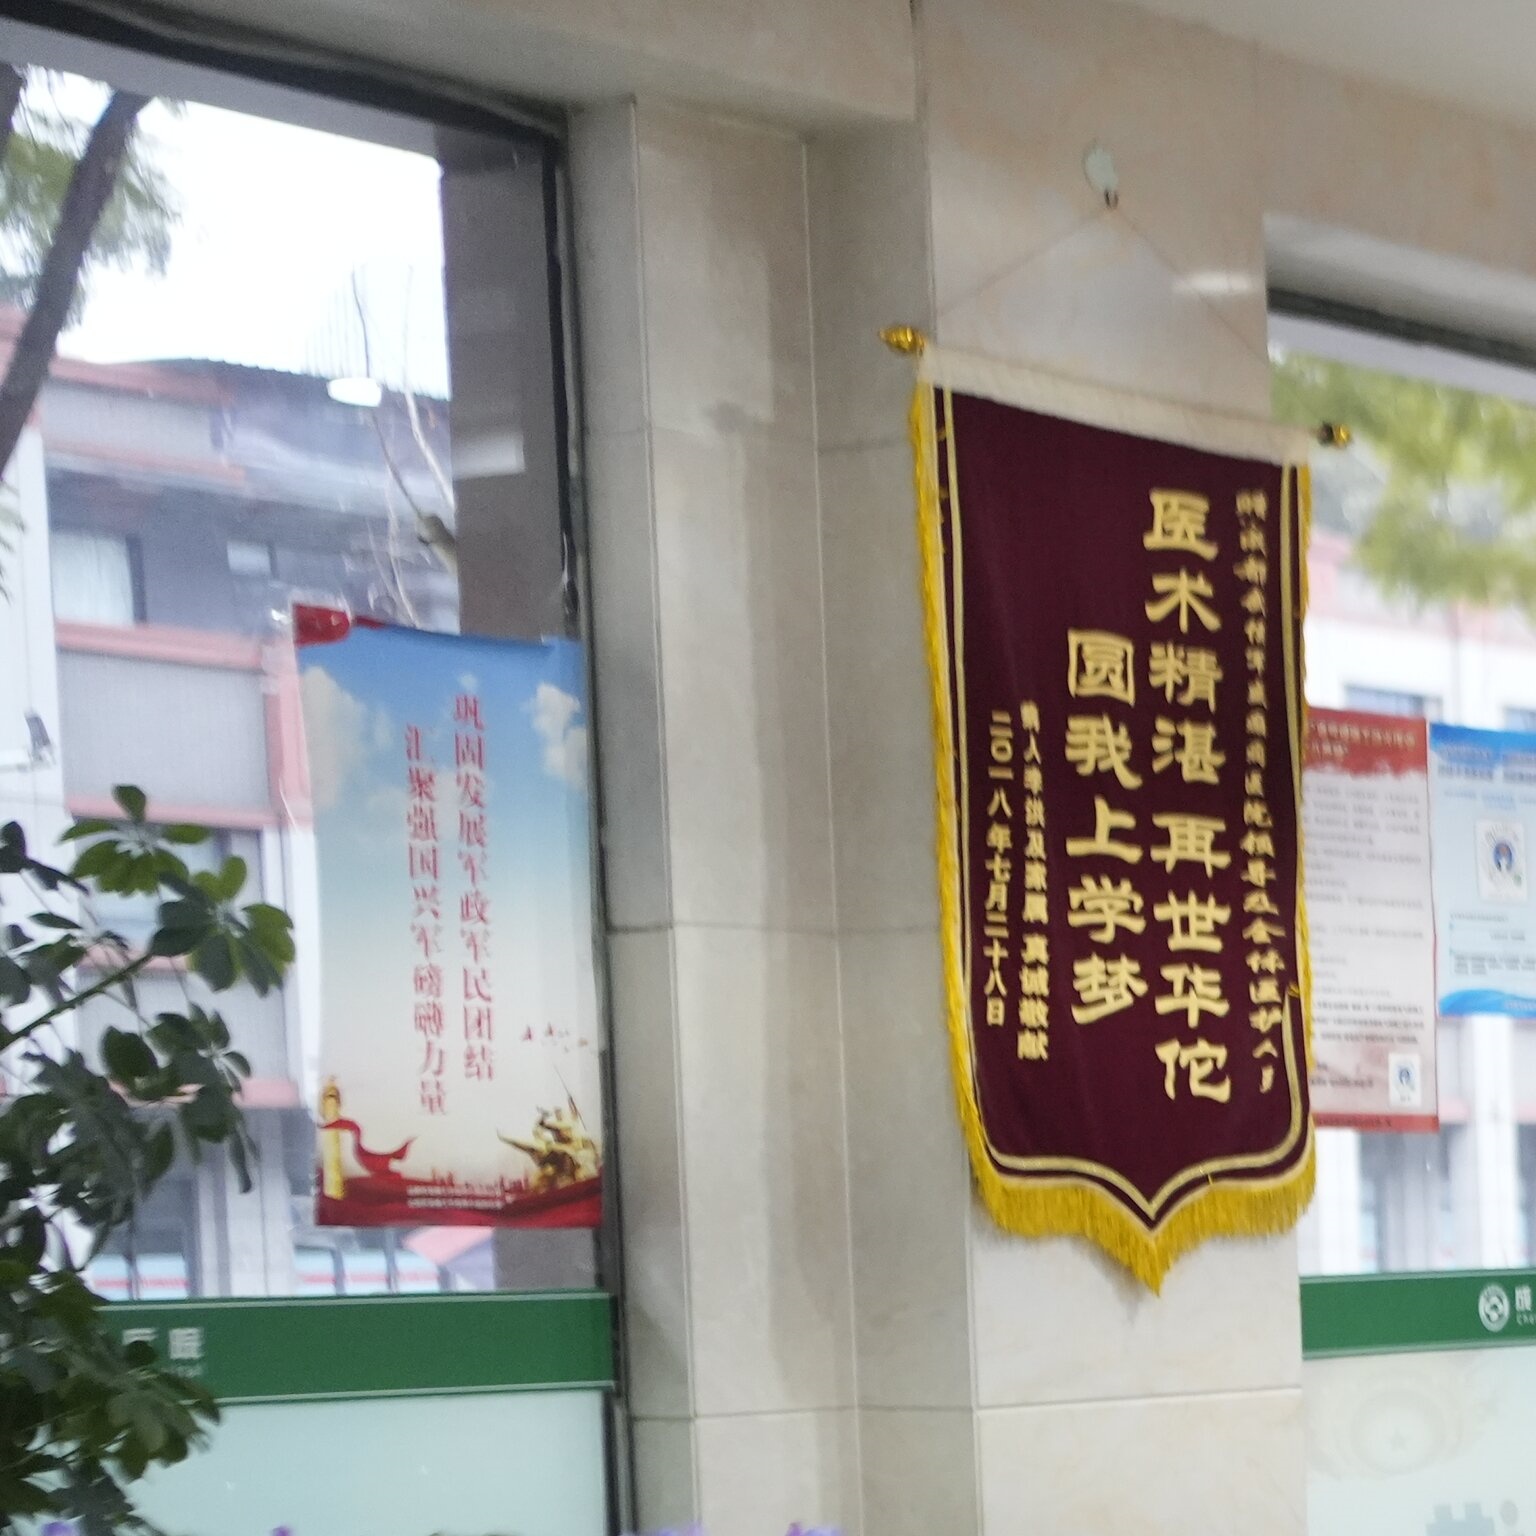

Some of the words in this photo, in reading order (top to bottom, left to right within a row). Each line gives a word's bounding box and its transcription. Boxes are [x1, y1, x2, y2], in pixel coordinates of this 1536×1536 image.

[406, 724, 447, 1115] 汇聚强国兴军磅礴力量
[453, 694, 495, 1082] 巩固发展军政军民团结
[1065, 629, 1147, 1026] 圆我上学梦
